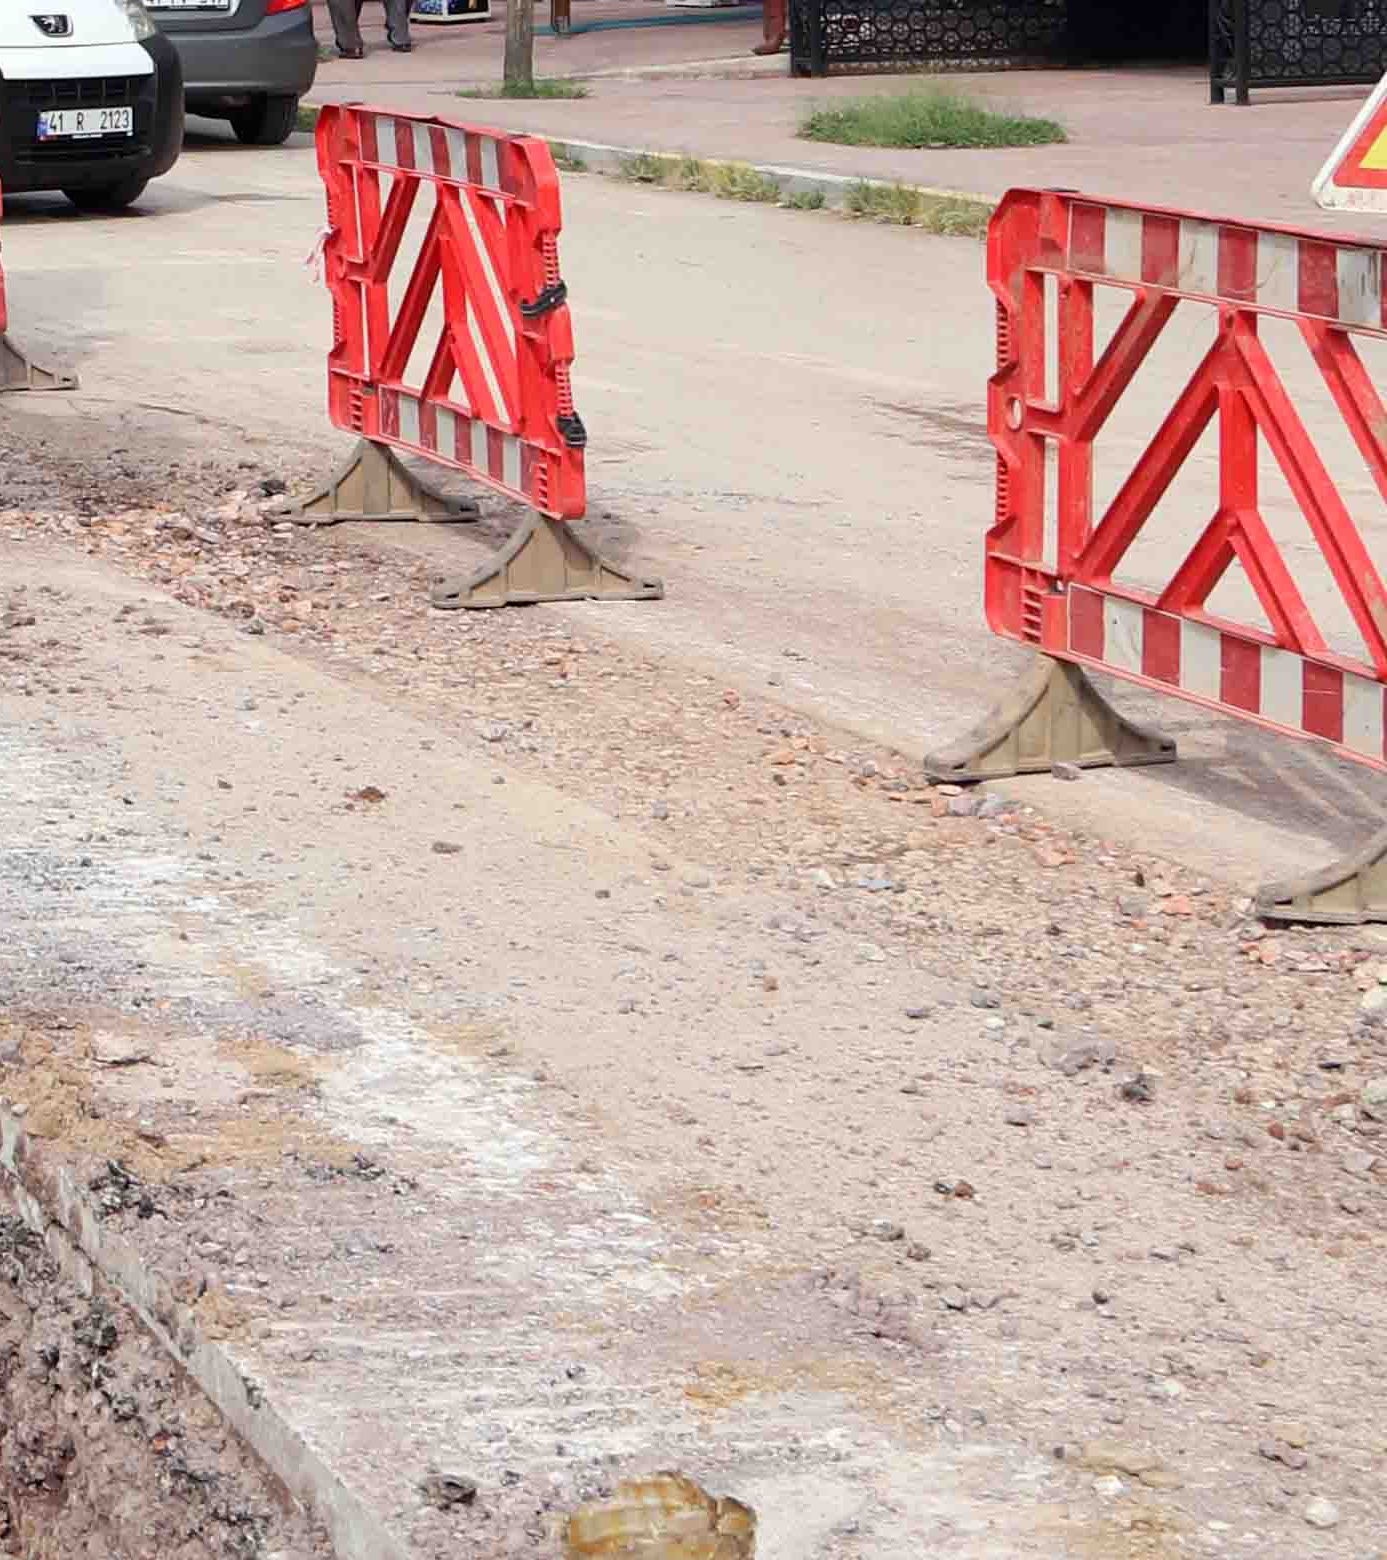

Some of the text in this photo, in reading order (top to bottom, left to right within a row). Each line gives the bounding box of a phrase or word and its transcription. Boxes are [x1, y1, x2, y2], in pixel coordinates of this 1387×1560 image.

[49, 110, 130, 130] 41 R 2123
